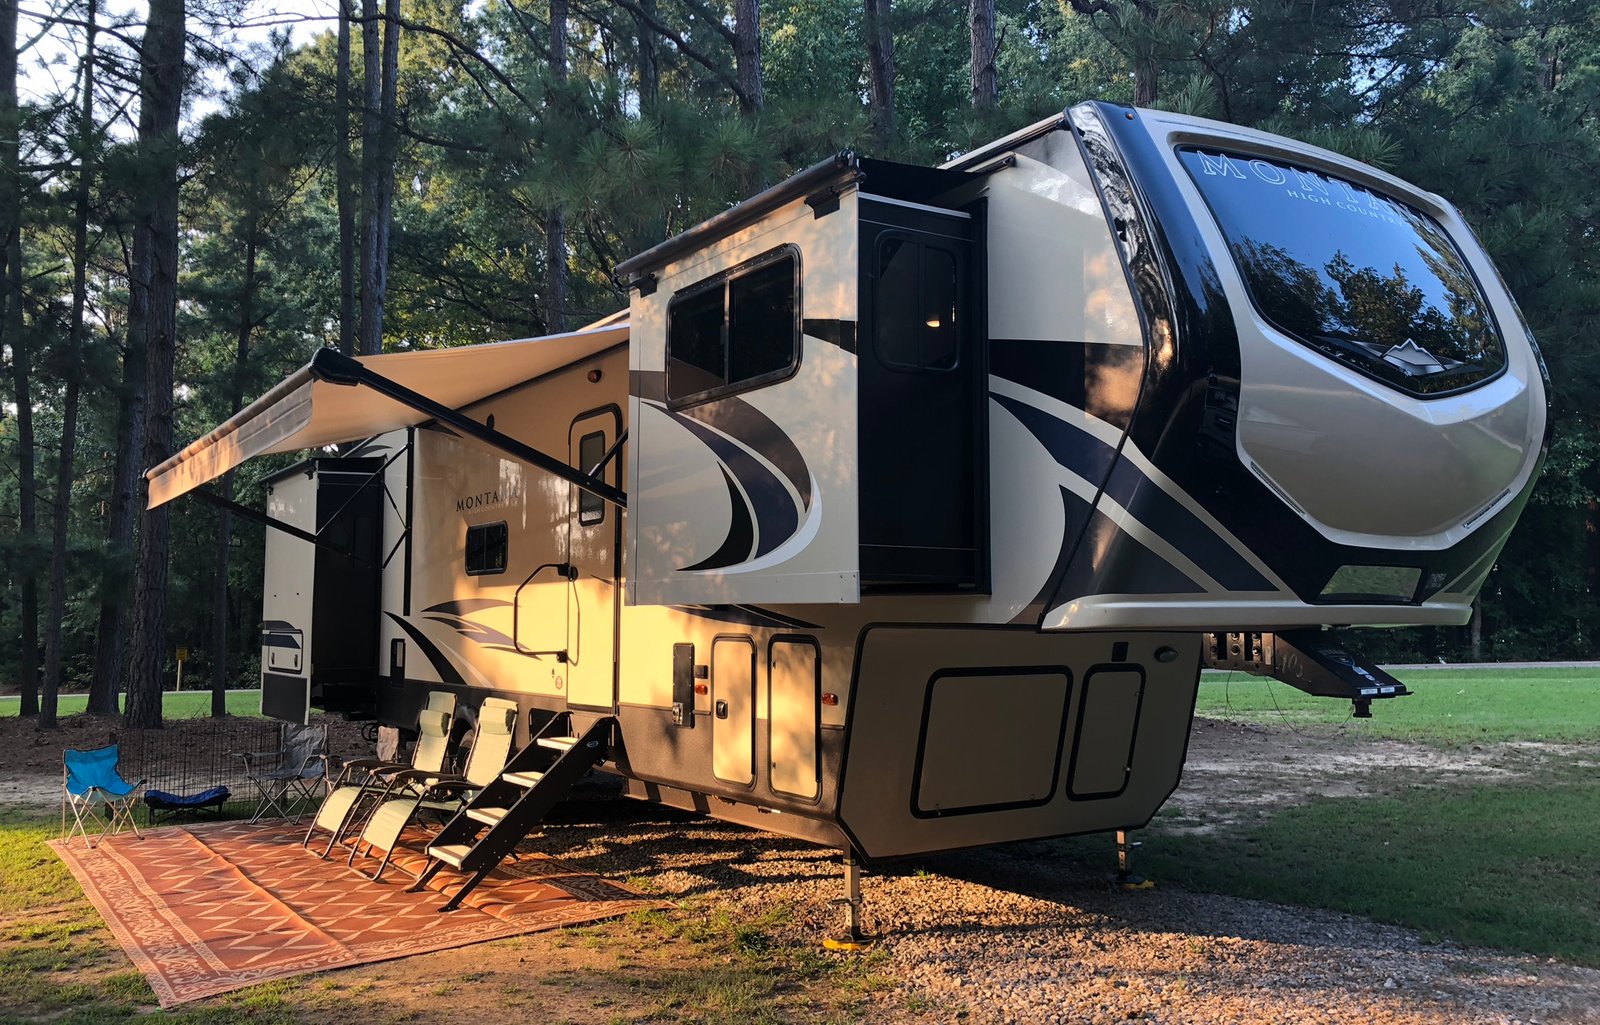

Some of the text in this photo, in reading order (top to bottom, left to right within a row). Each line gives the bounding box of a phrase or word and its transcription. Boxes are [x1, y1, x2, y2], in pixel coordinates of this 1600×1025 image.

[1286, 189, 1403, 227] HIGH COUNTRY
[456, 488, 517, 512] MONTA
